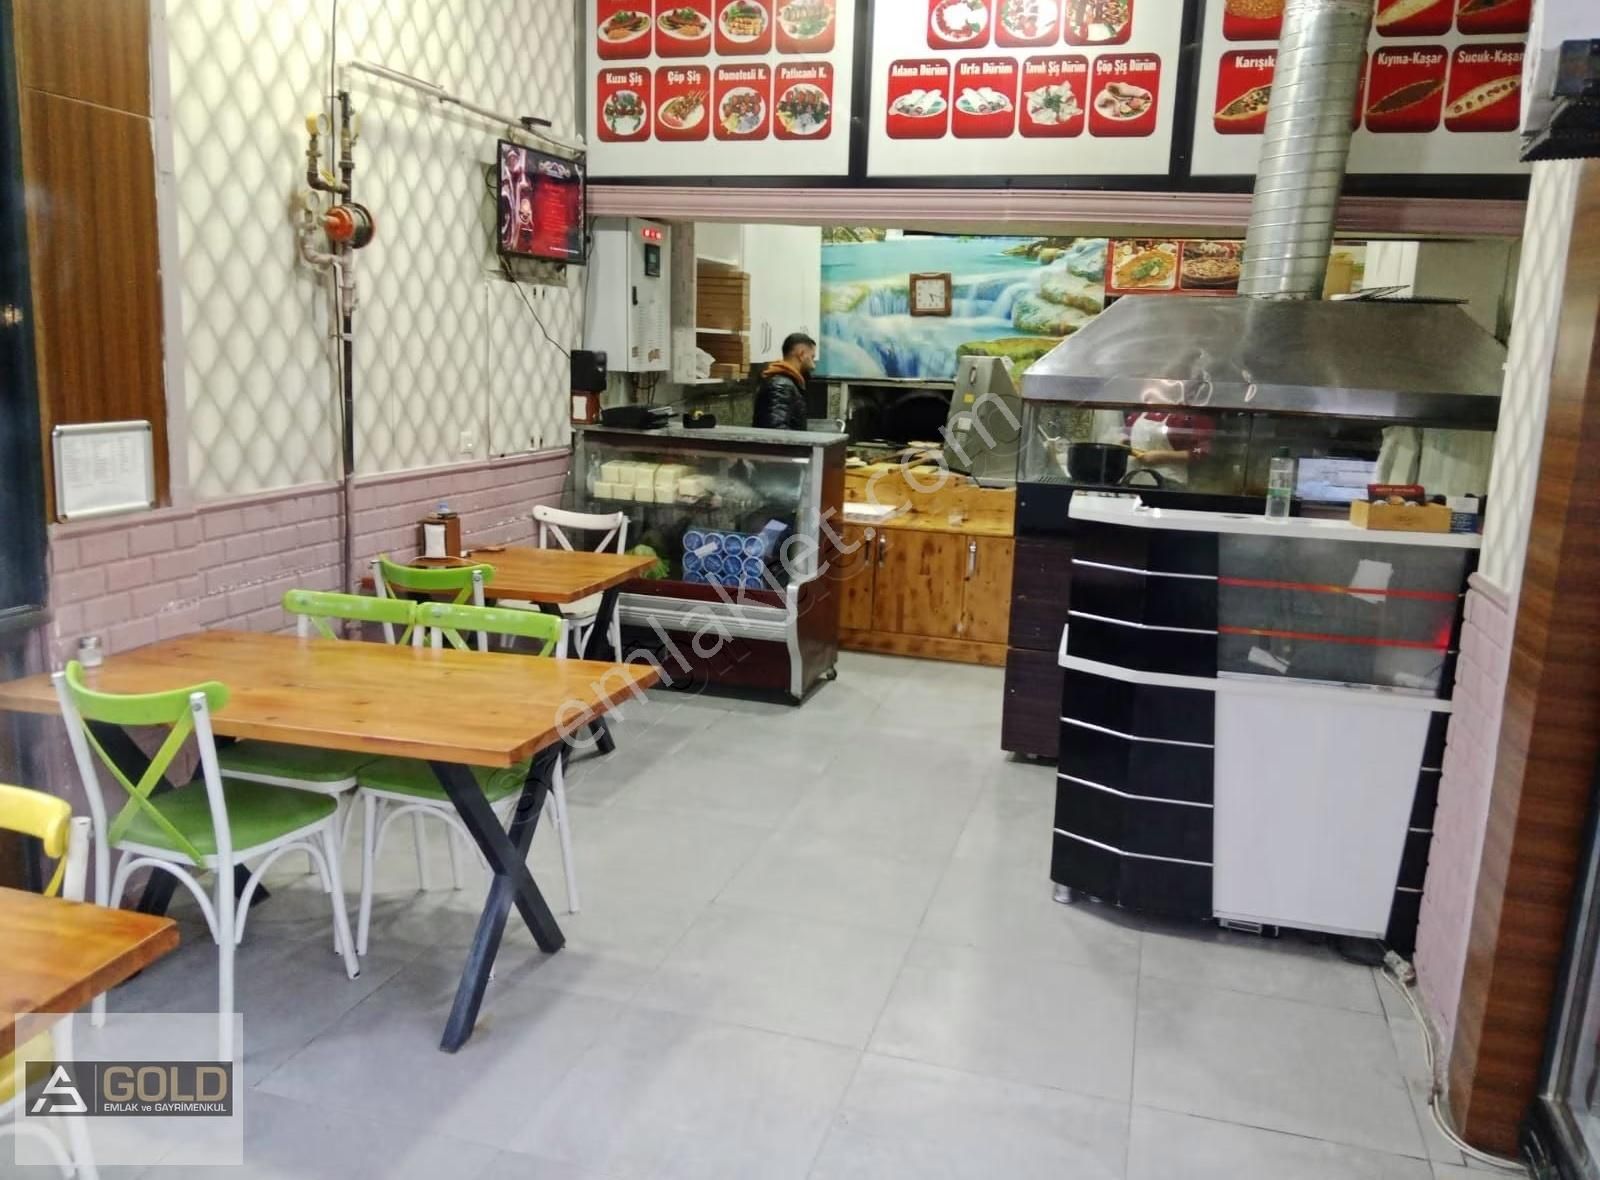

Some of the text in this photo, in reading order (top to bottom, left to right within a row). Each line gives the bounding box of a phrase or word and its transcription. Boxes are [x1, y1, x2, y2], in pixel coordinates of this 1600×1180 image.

[1377, 52, 1443, 68] Kıyma-Kaşar
[891, 65, 918, 76] Adana
[960, 63, 981, 75] Urfa
